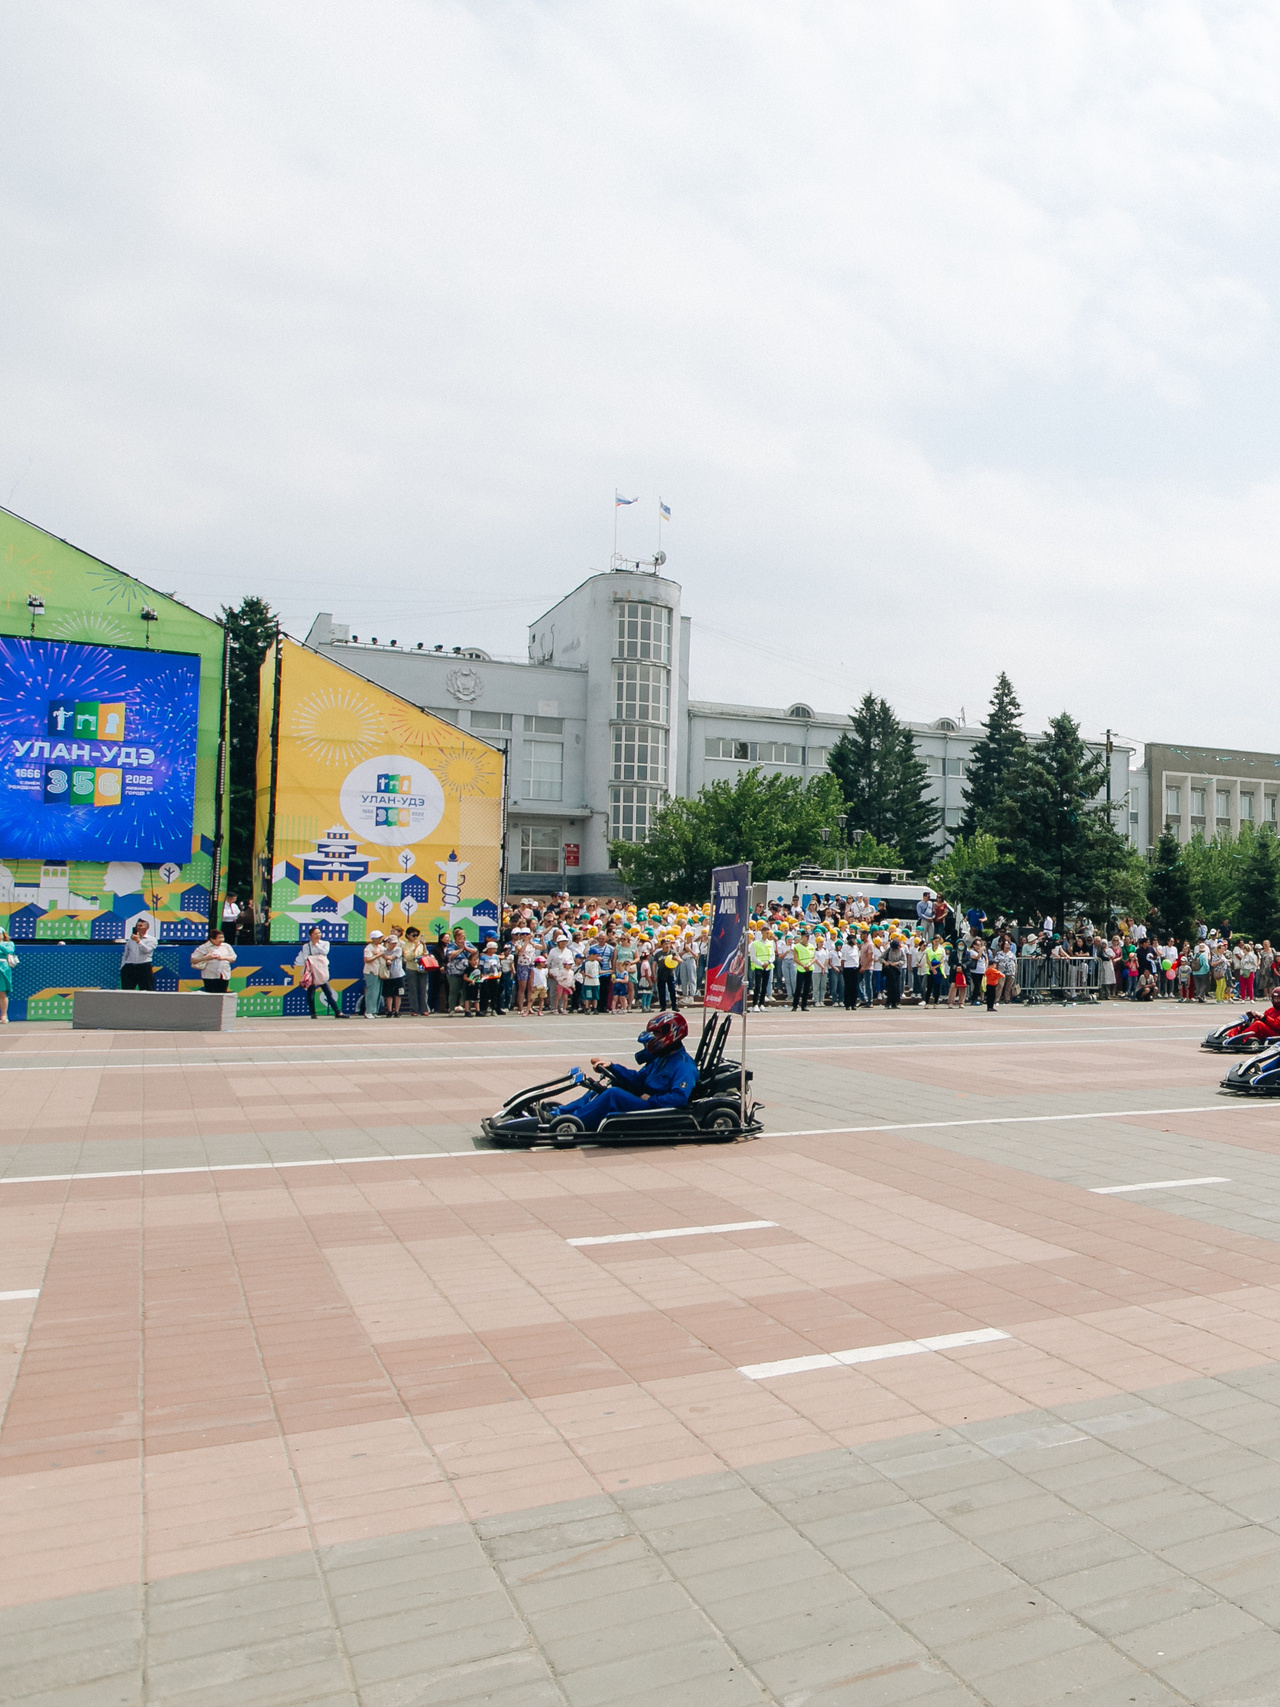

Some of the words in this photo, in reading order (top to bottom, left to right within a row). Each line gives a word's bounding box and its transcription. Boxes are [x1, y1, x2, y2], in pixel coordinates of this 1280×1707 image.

[12, 740, 156, 767] УЛАН-УДЭ
[15, 768, 41, 779] 1666
[125, 774, 154, 785] 2022
[47, 769, 120, 796] 356
[361, 795, 425, 807] УЛАН-УДЭ
